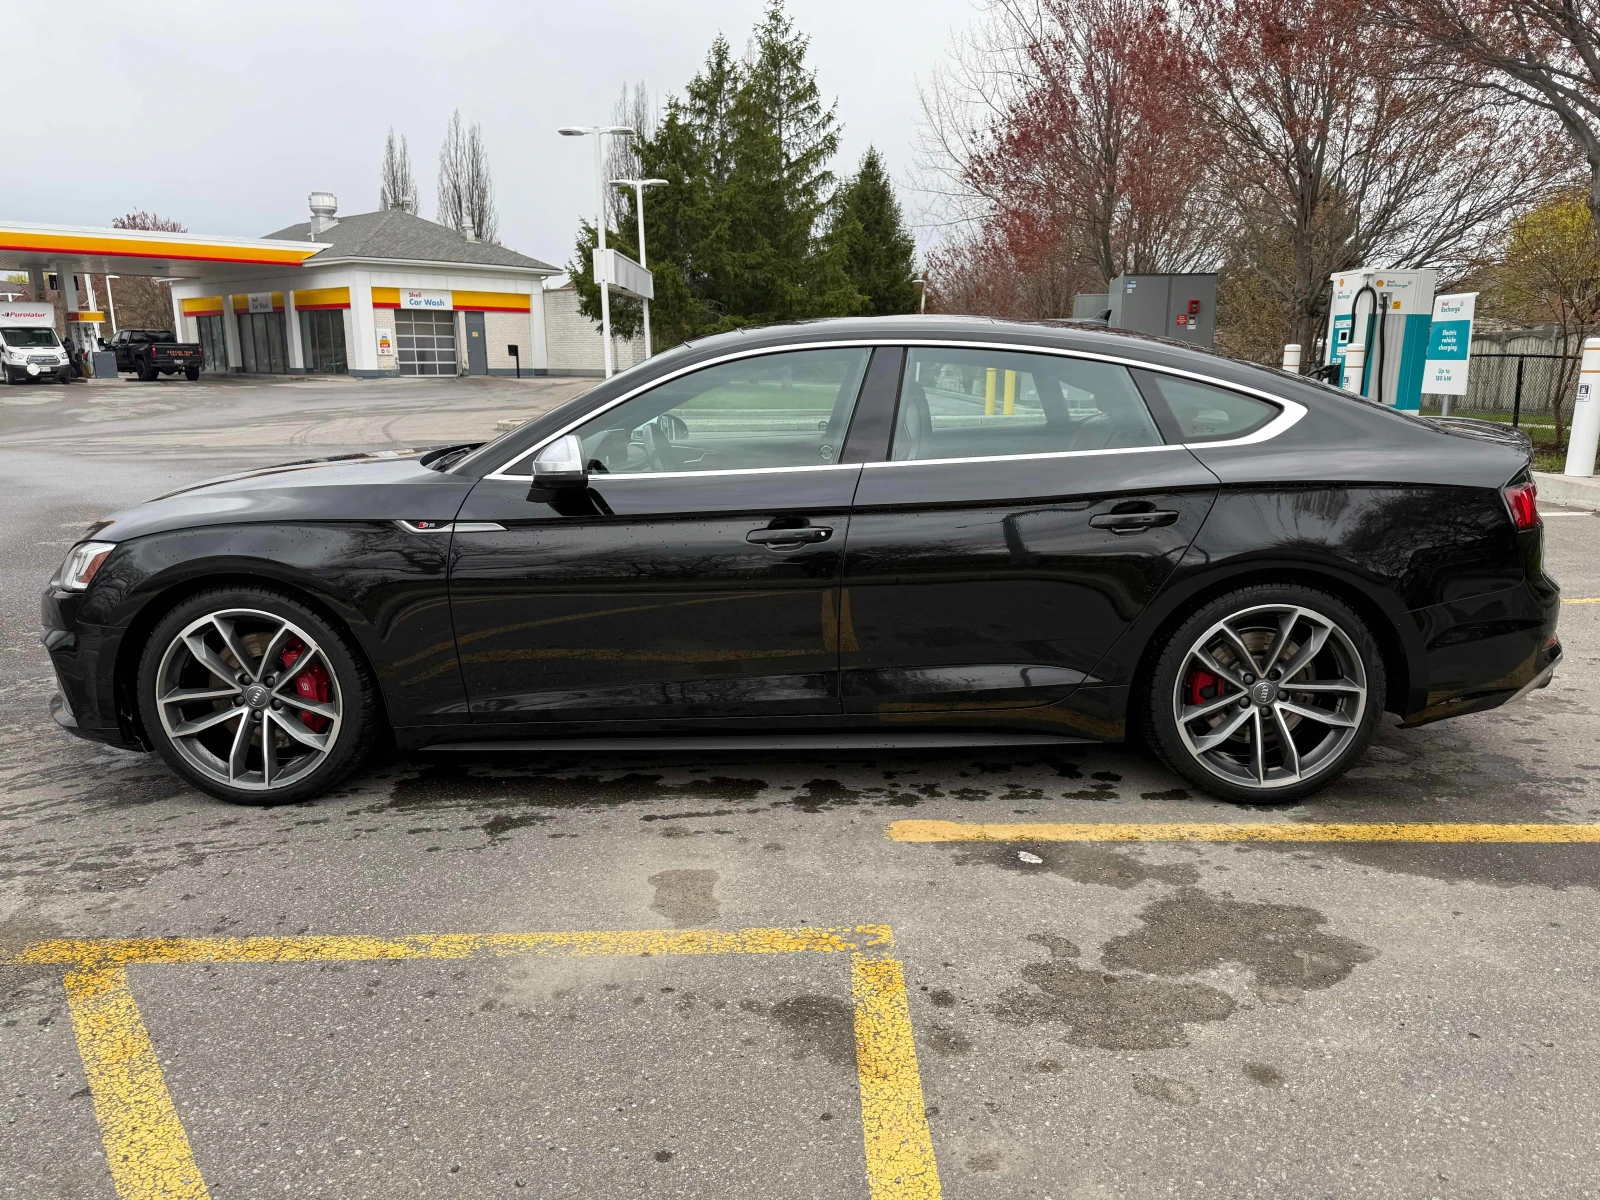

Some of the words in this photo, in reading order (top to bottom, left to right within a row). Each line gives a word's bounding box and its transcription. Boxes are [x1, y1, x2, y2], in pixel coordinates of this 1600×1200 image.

[409, 298, 423, 306] Car
[423, 299, 445, 307] Wash
[1438, 344, 1458, 352] charging
